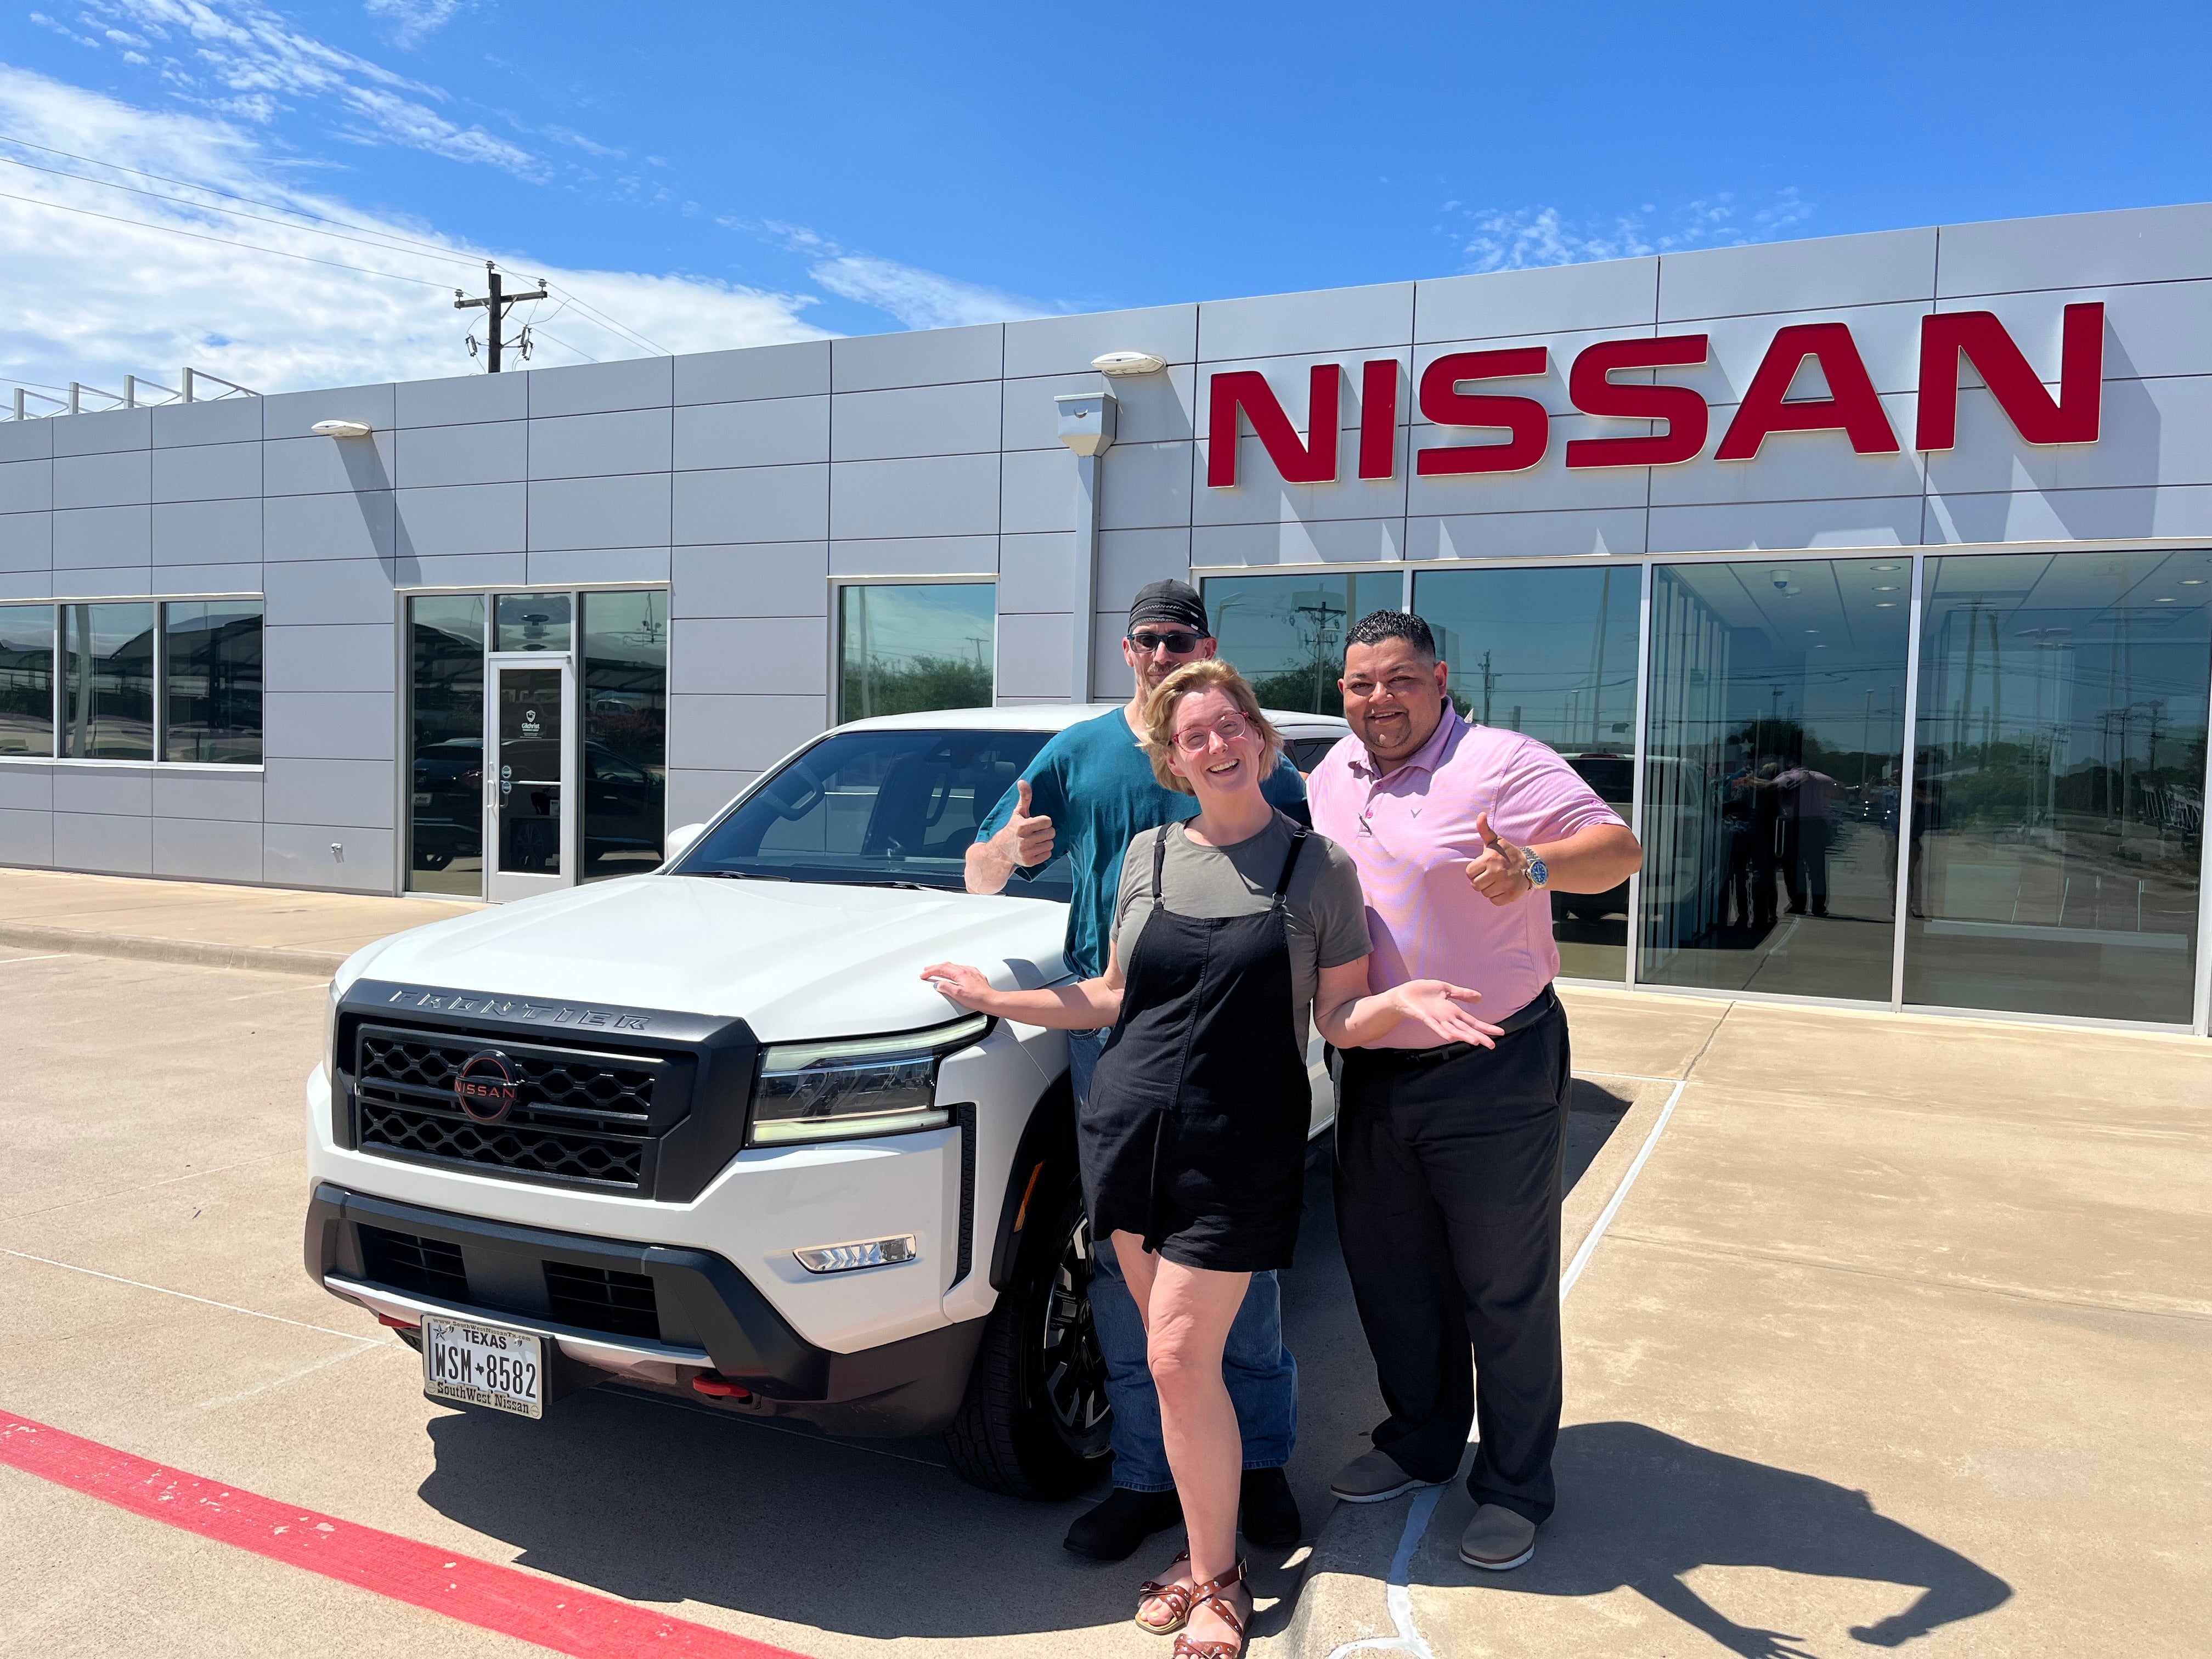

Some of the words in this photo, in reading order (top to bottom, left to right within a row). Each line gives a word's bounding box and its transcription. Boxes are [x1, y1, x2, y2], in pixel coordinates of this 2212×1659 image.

[1208, 301, 2104, 488] NISSAN
[389, 990, 651, 1030] FRONTIER
[455, 1080, 515, 1098] NISSAN
[463, 1329, 507, 1350] TEXAS
[436, 1343, 472, 1383] WSM
[487, 1354, 536, 1398] 8582
[438, 1380, 492, 1404] SouthWest
[495, 1393, 529, 1414] Nissan
